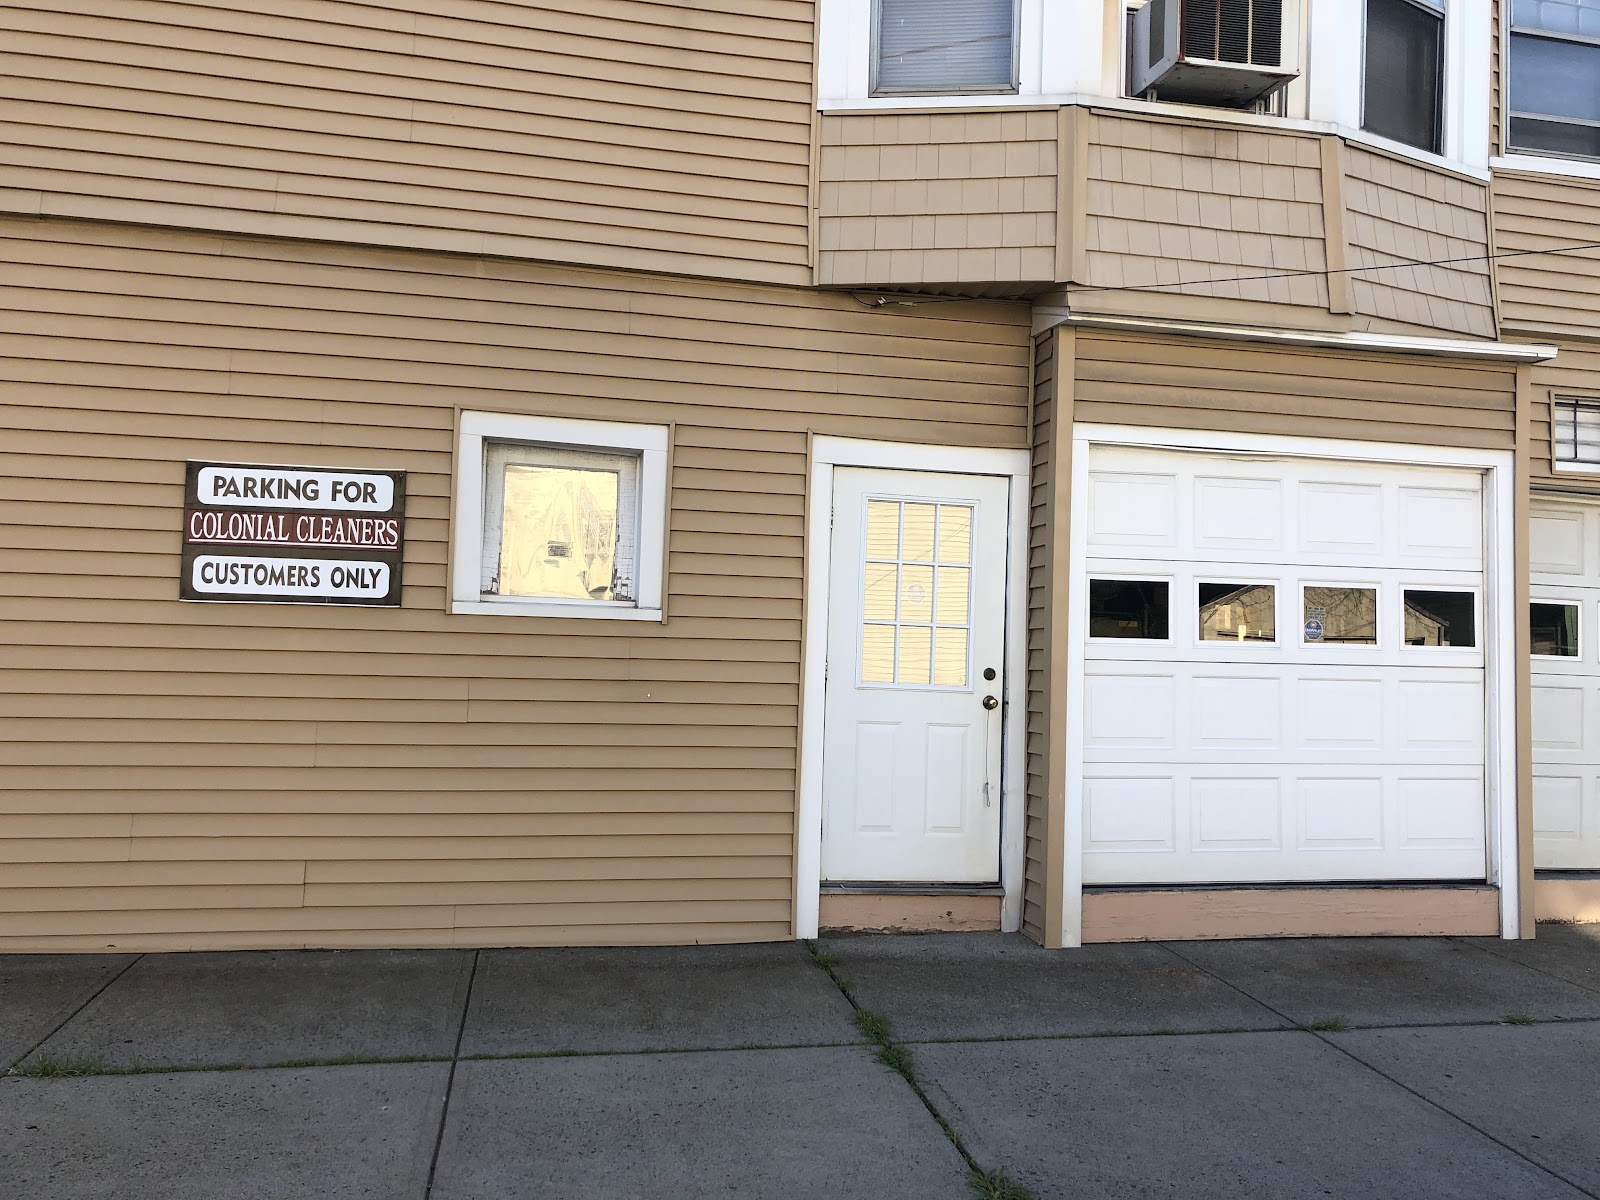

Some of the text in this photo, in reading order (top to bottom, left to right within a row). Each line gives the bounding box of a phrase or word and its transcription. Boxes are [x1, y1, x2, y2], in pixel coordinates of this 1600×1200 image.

[213, 475, 377, 504] PARKING FOR
[190, 511, 398, 546] COLONIAL CLEANERS
[200, 561, 382, 589] CUSTOMERS ONLY
